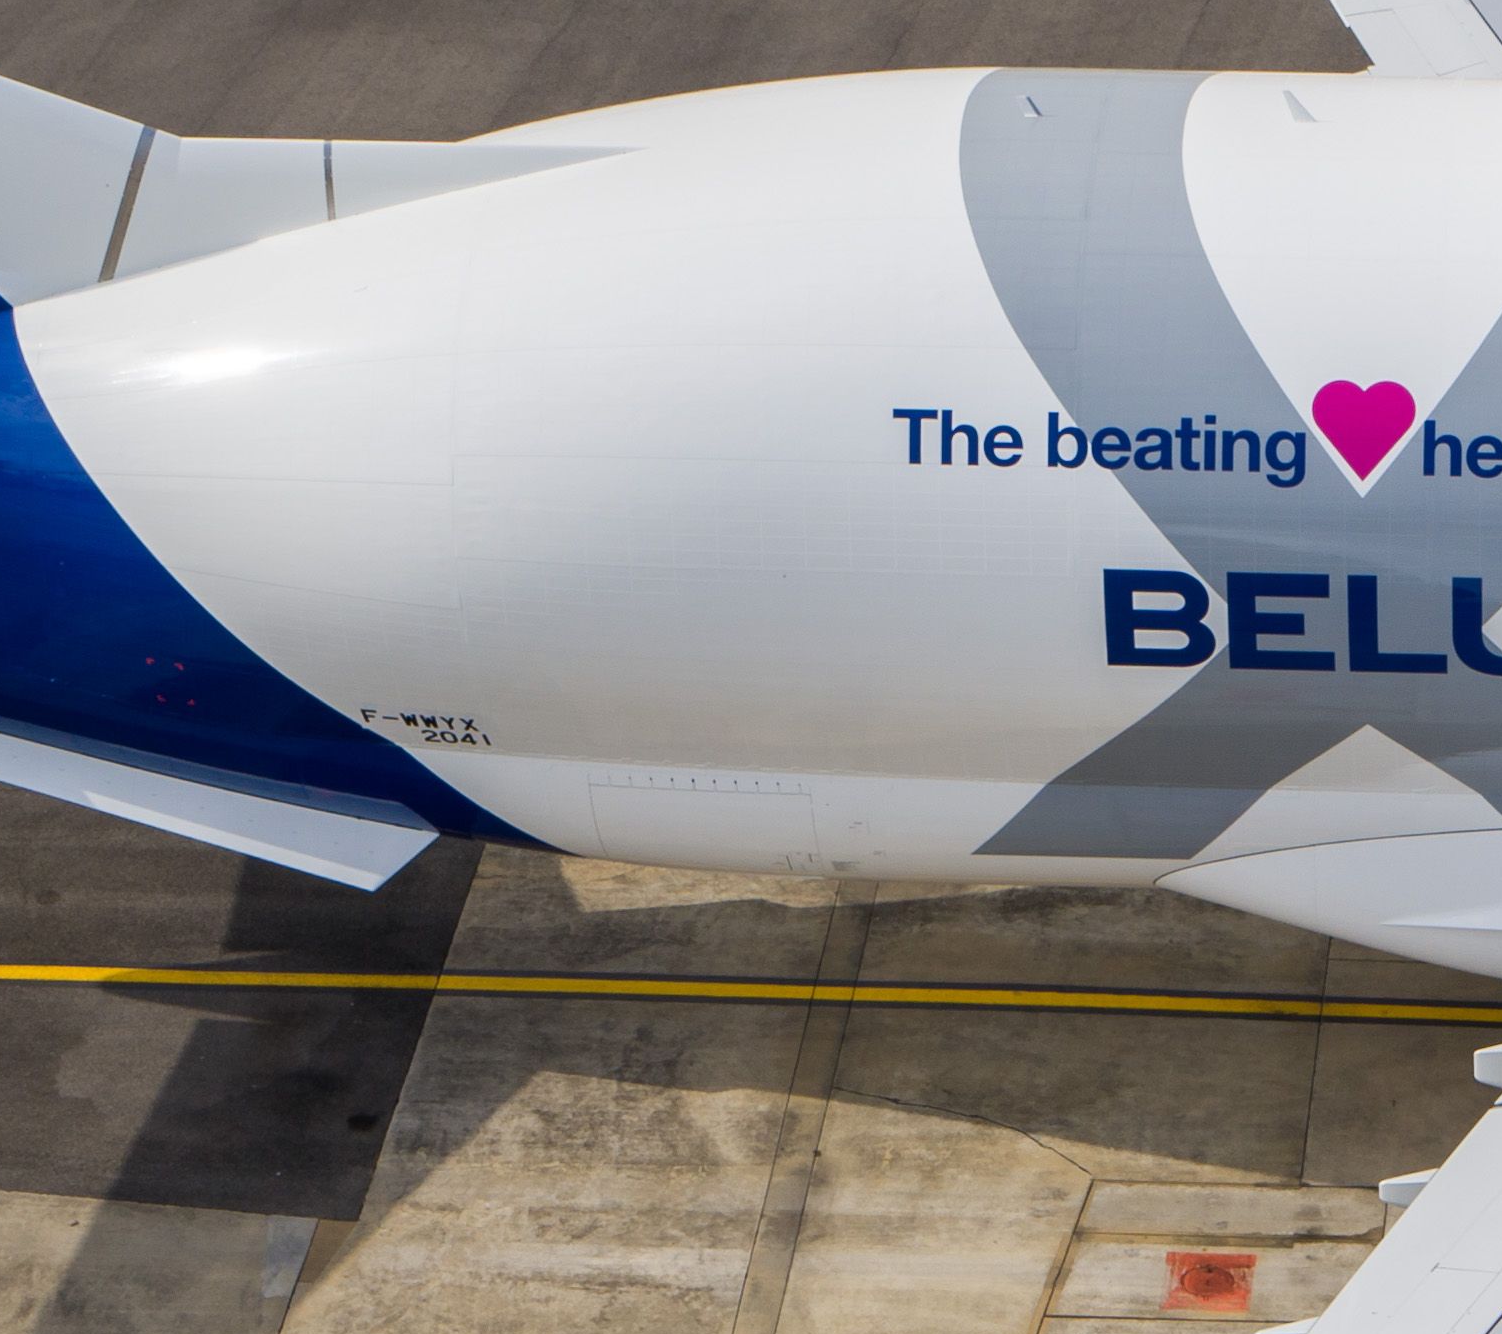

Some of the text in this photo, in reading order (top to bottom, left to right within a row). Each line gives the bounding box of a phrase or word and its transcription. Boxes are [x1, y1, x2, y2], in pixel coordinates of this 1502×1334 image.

[893, 407, 1024, 468] The
[1047, 411, 1308, 489] beating
[360, 708, 479, 732] F-WWYX
[421, 729, 492, 746] 2041
